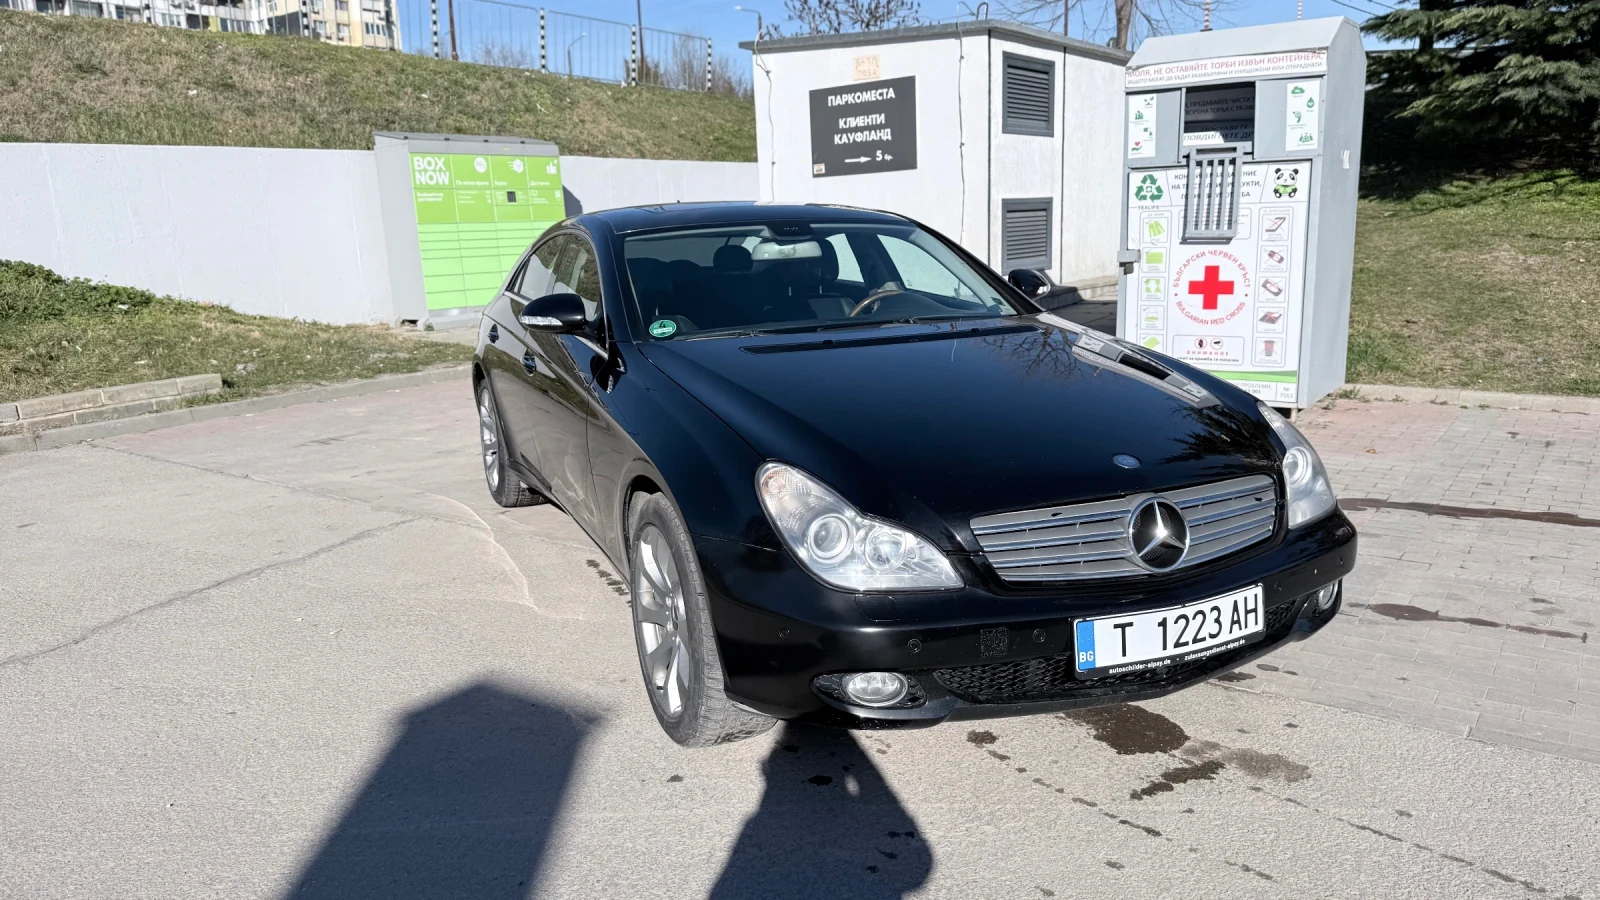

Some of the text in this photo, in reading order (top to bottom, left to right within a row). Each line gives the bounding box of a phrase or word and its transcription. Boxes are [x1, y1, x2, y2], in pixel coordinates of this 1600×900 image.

[1165, 64, 1208, 74] ОСТАВЯЙТЕ
[1211, 60, 1235, 70] ТОРБИ
[1238, 58, 1265, 68] ИЗВЪН
[828, 88, 896, 106] ПАРКОМЕСТА
[1190, 98, 1228, 107] ПРЕДАВАЙТЕ
[838, 113, 885, 128] КЛИЕНТИ
[834, 128, 892, 144] КАУФЛАНД
[876, 150, 882, 161] 5
[414, 157, 446, 171] BOX
[416, 171, 449, 186] NOW
[1173, 250, 1250, 288] БЪЛГАРСКИ ЧЕРВЕН КРЪСТ
[1176, 301, 1208, 325] BULGARIAN
[1226, 302, 1246, 321] CROSS
[1113, 592, 1258, 657] T 1223 AH
[1079, 651, 1094, 663] BG
[1109, 638, 1246, 674] autoschilder-alpay.de zulassungsdienst-alpay.de
